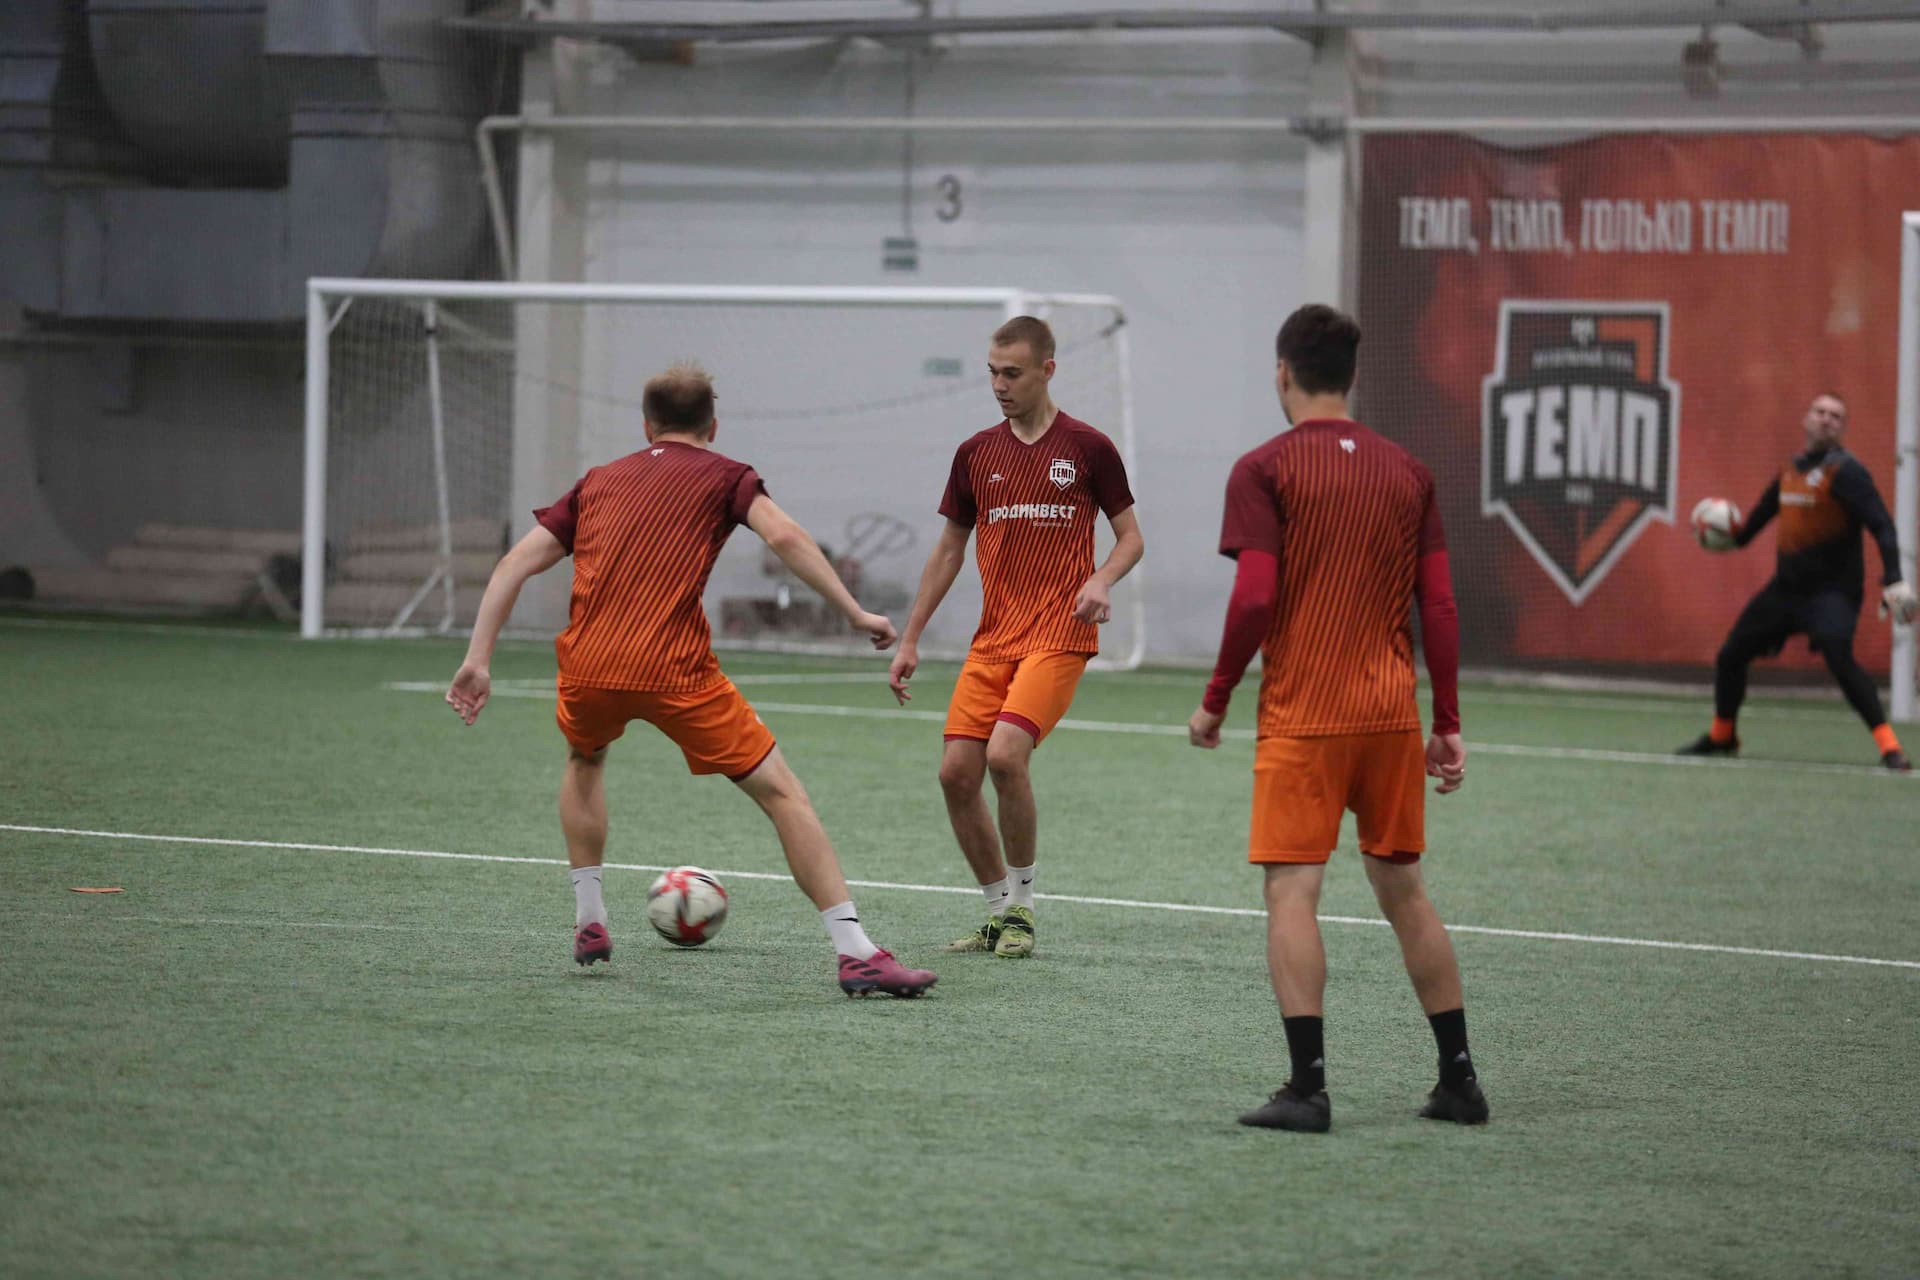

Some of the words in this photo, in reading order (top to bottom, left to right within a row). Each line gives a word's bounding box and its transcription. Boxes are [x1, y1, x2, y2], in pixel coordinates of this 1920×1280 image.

[936, 174, 963, 223] 3
[1399, 197, 1479, 255] ТЕМП,
[1488, 199, 1574, 256] ТЕМП,
[1581, 199, 1691, 253] ТОЛЬКО
[1700, 200, 1790, 253] ТЕМП!
[1501, 384, 1660, 492] ТЕМП
[1052, 467, 1075, 480] ТЕМП
[988, 504, 1076, 525] ПРОДИНВЕСТ
